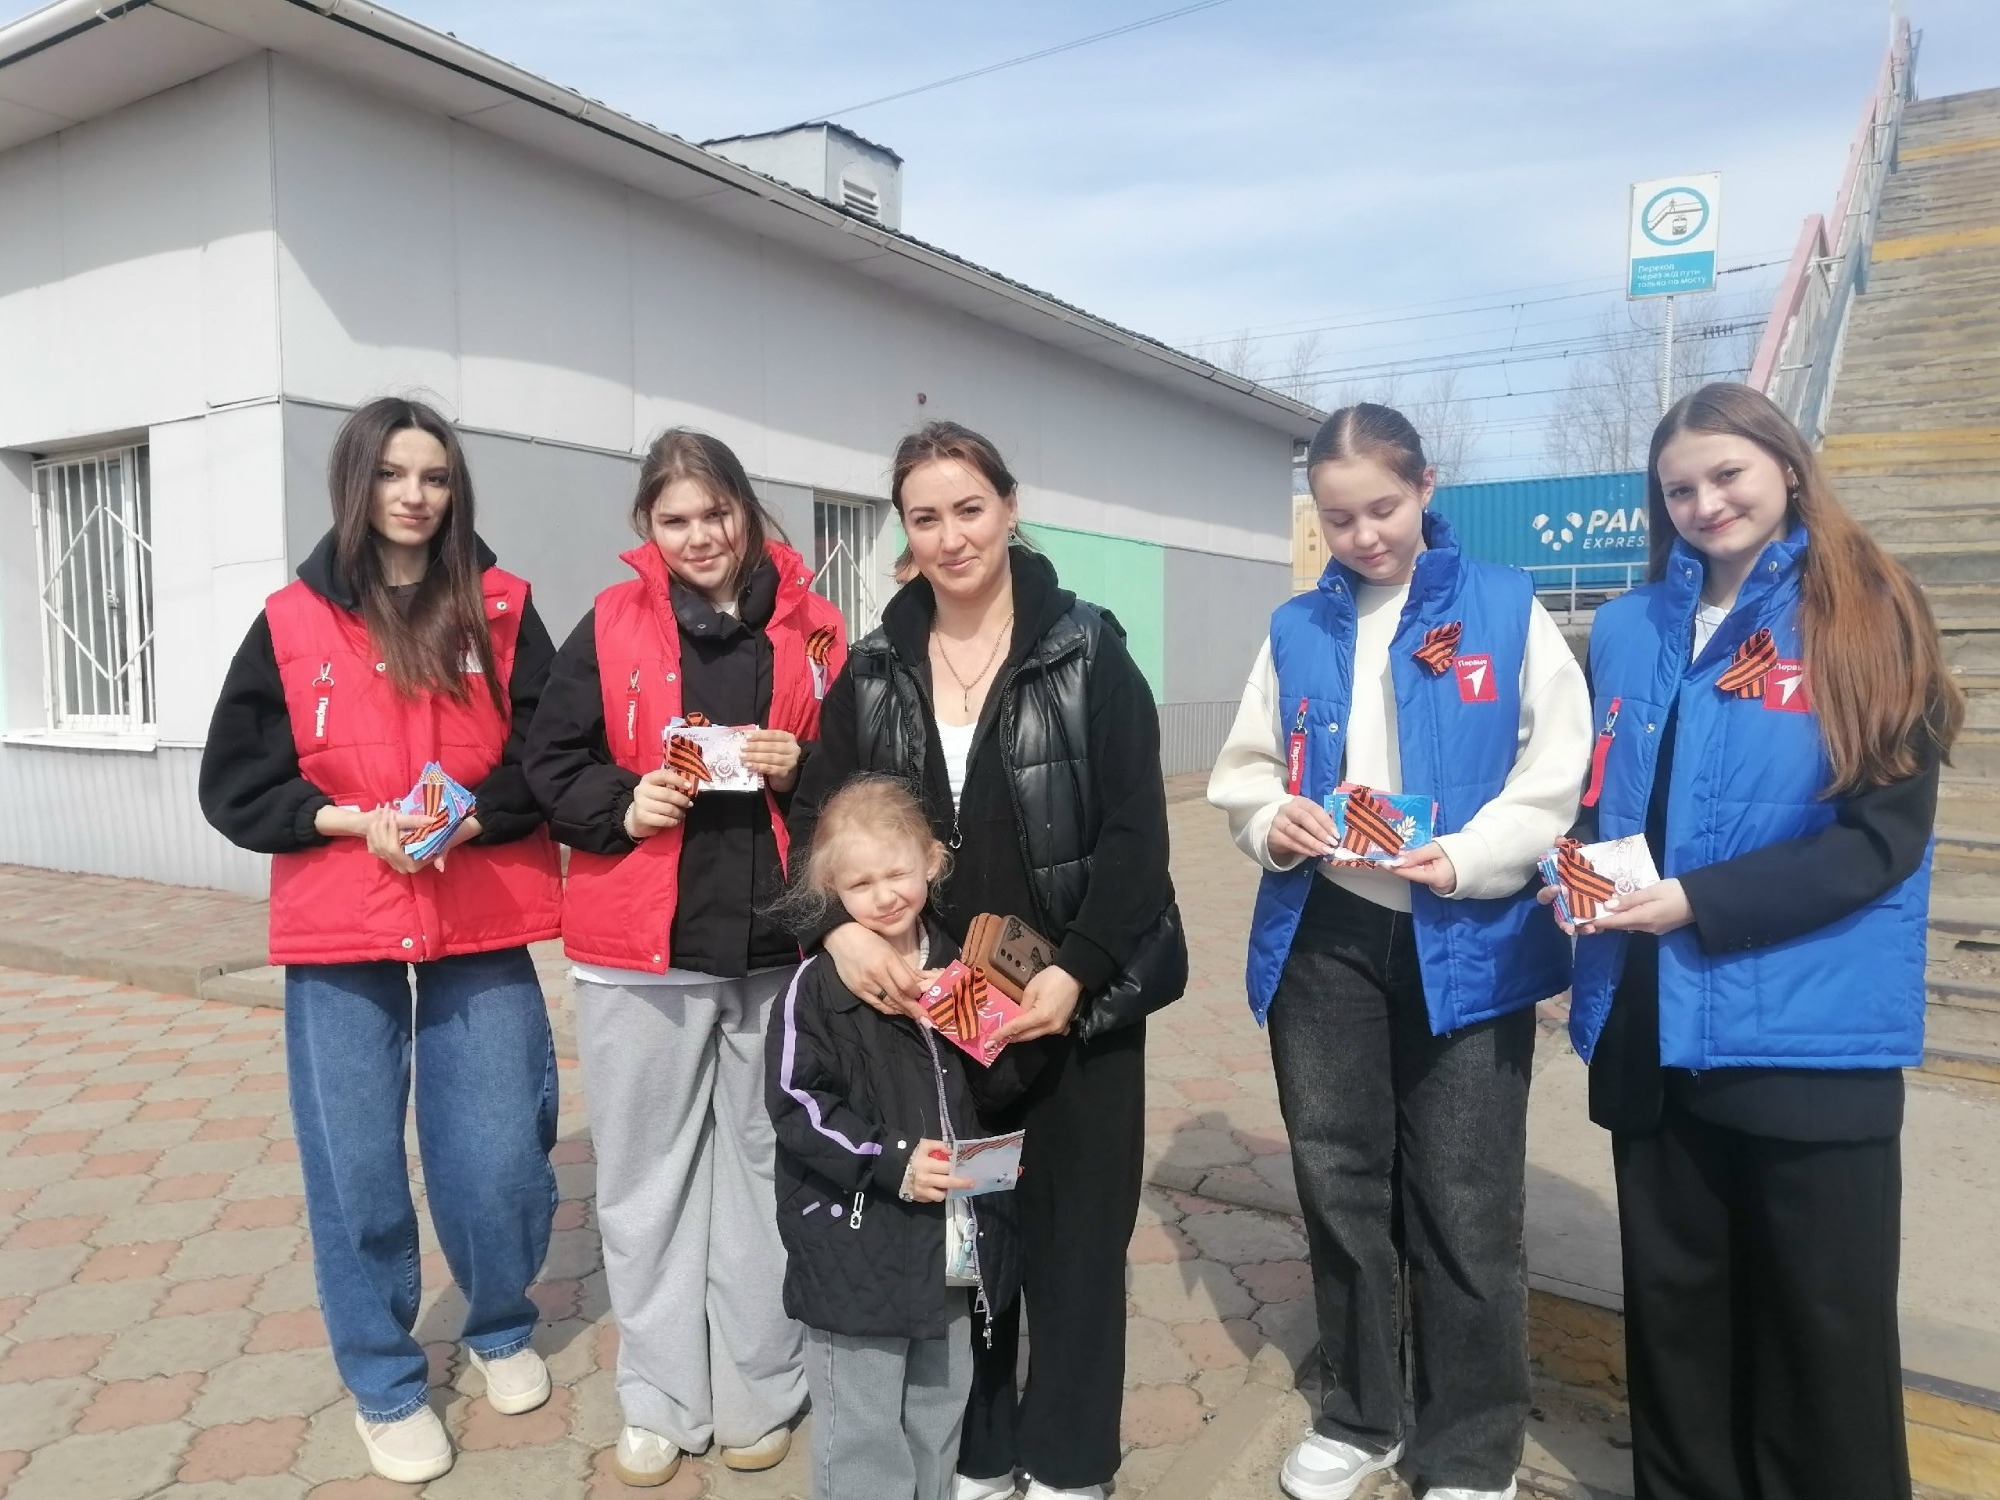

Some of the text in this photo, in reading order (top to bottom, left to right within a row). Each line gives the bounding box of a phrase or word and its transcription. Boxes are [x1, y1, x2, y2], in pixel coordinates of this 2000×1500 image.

[1638, 264, 1675, 273] Переход
[1638, 272, 1662, 281] через
[1638, 280, 1666, 288] только
[1680, 276, 1706, 284] мосту
[1583, 535, 1650, 549] EXPRES
[1775, 662, 1803, 672] Перв
[315, 697, 329, 738] Первые
[1291, 741, 1302, 782] Первые
